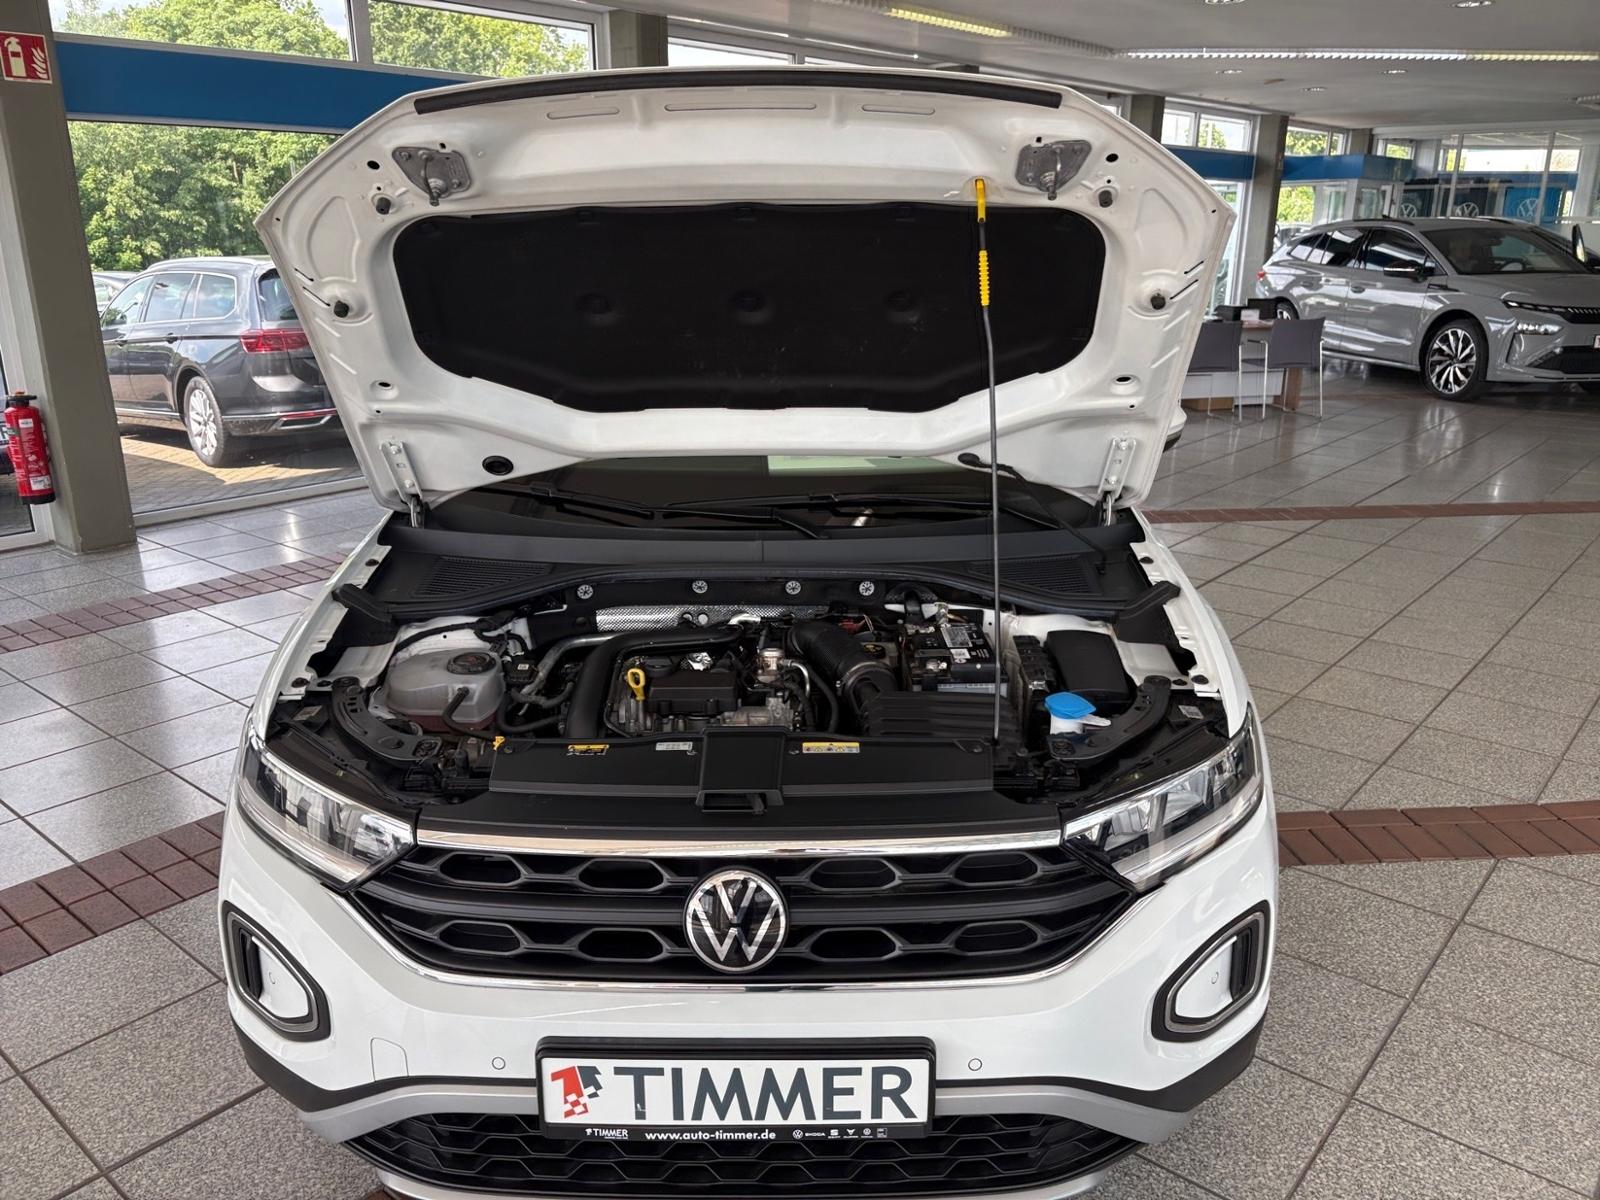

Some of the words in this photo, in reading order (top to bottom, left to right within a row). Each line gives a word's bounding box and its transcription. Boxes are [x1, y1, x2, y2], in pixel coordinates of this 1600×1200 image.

[613, 1066, 918, 1121] TIMMER
[593, 1128, 628, 1137] TIMMER
[644, 1129, 777, 1140] www.auto-timmer.de
